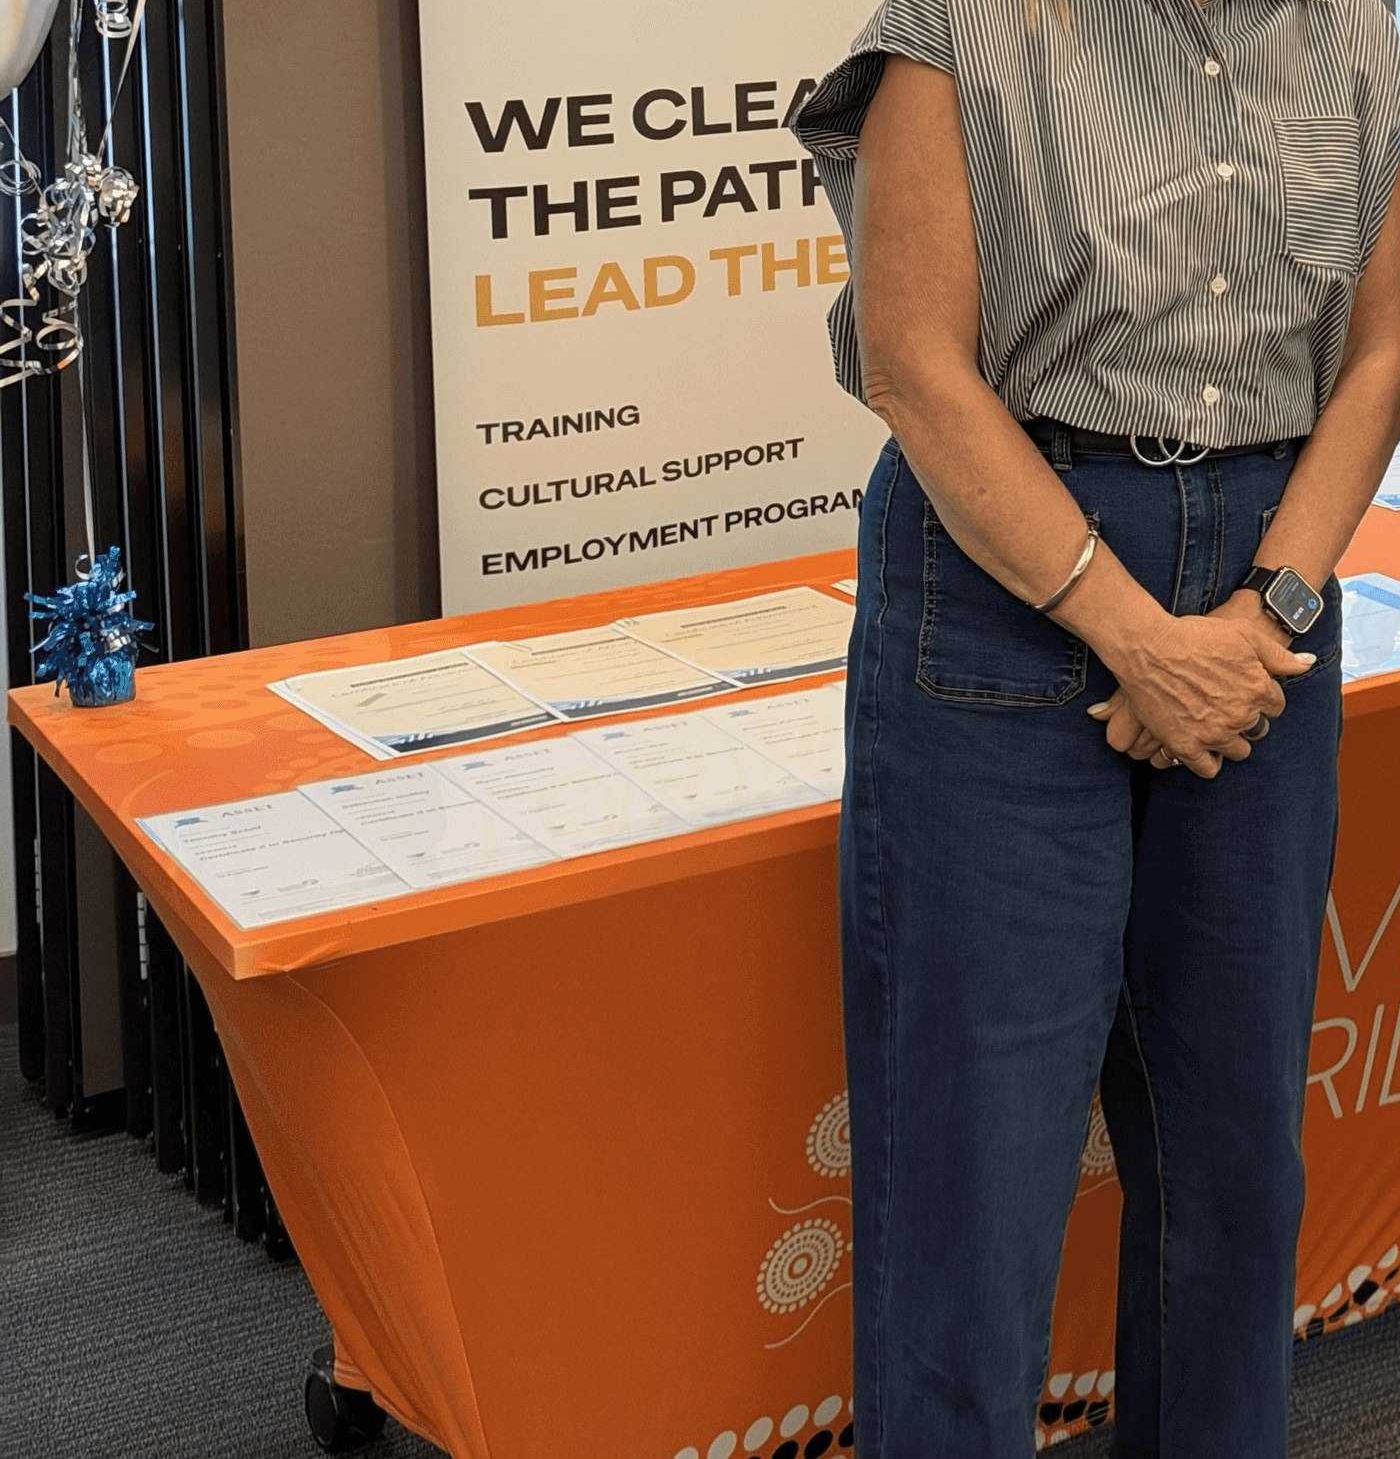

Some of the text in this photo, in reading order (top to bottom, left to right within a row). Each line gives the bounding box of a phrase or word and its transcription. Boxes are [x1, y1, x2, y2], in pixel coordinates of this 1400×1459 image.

[464, 93, 615, 154] WE
[468, 175, 642, 240] THE
[474, 234, 852, 327] LEAD THE
[476, 405, 641, 445] TRAINING
[478, 438, 805, 510] CULTURAL SUPPORT
[481, 515, 719, 575] EMPLOYMENT
